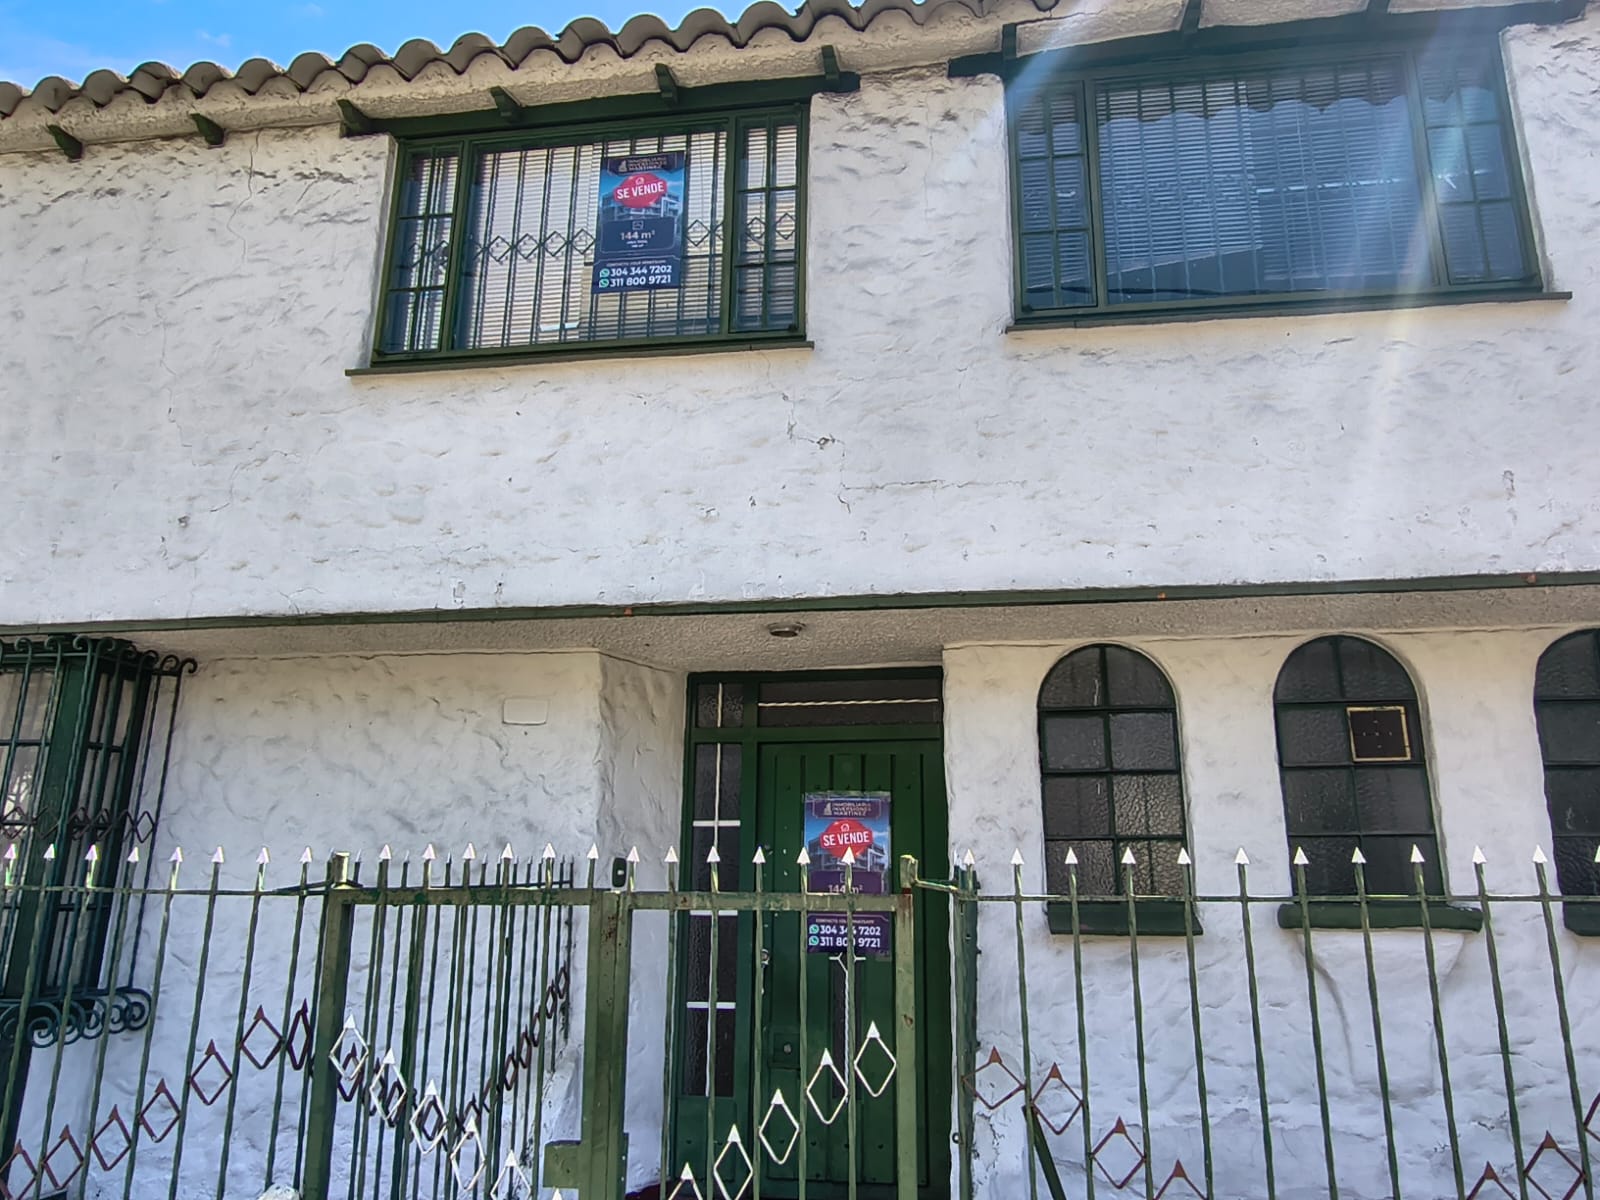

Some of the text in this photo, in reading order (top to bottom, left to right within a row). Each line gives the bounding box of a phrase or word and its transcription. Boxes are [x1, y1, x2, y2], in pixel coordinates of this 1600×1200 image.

[616, 182, 664, 199] SE VENDE
[620, 232, 639, 240] 144
[610, 265, 672, 277] 304 344 7202
[610, 275, 671, 287] 311 800 9721
[823, 831, 870, 846] SE VENDE
[820, 925, 837, 934] 304
[858, 926, 881, 935] 7202
[820, 937, 833, 946] 311
[858, 938, 880, 947] 9721
